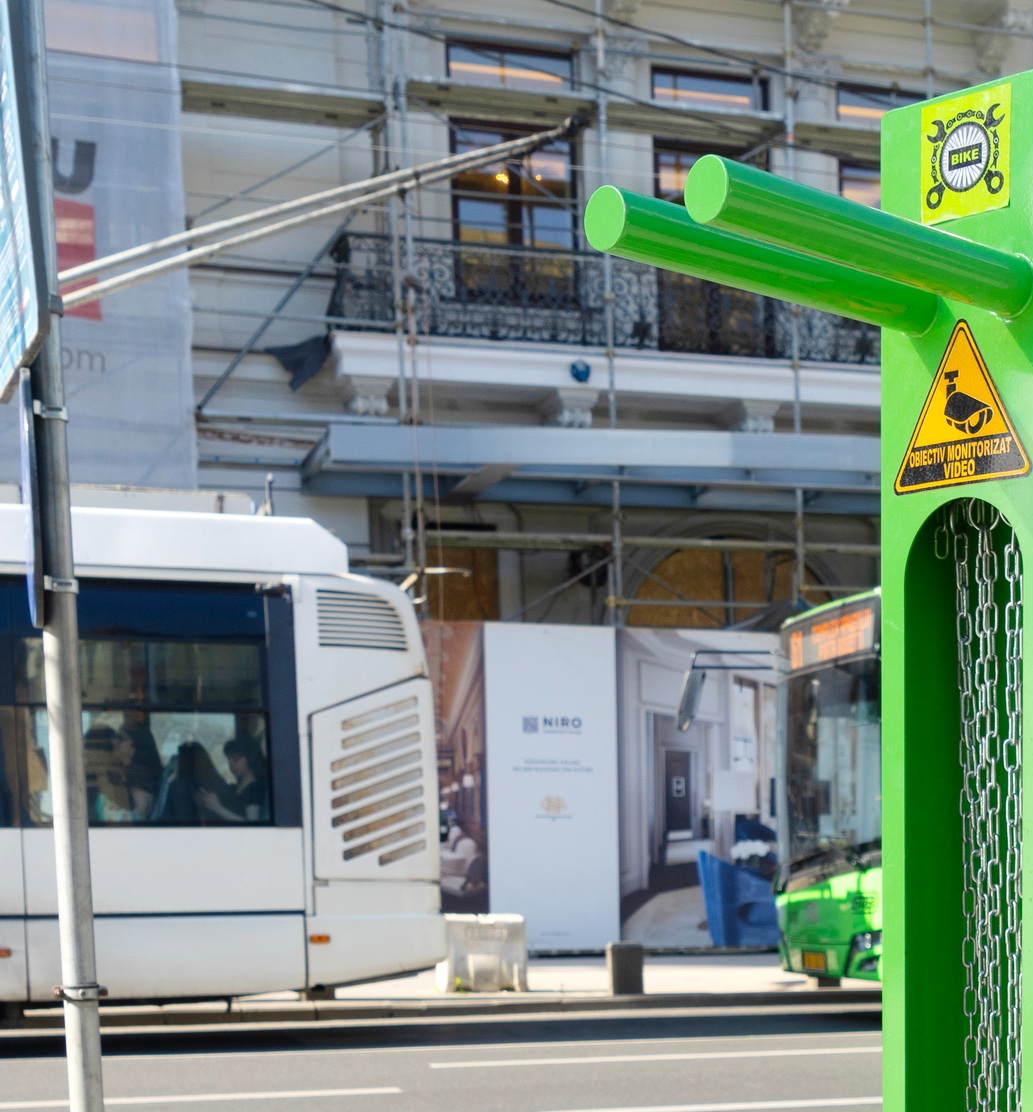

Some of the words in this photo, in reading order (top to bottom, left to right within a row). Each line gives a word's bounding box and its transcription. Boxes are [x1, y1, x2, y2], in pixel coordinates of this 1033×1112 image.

[951, 148, 979, 166] BIKE
[909, 447, 946, 468] OBIECTIV
[947, 436, 1012, 462] MONITORIZAT
[943, 459, 976, 479] VIDEO
[542, 716, 583, 729] NIRO
